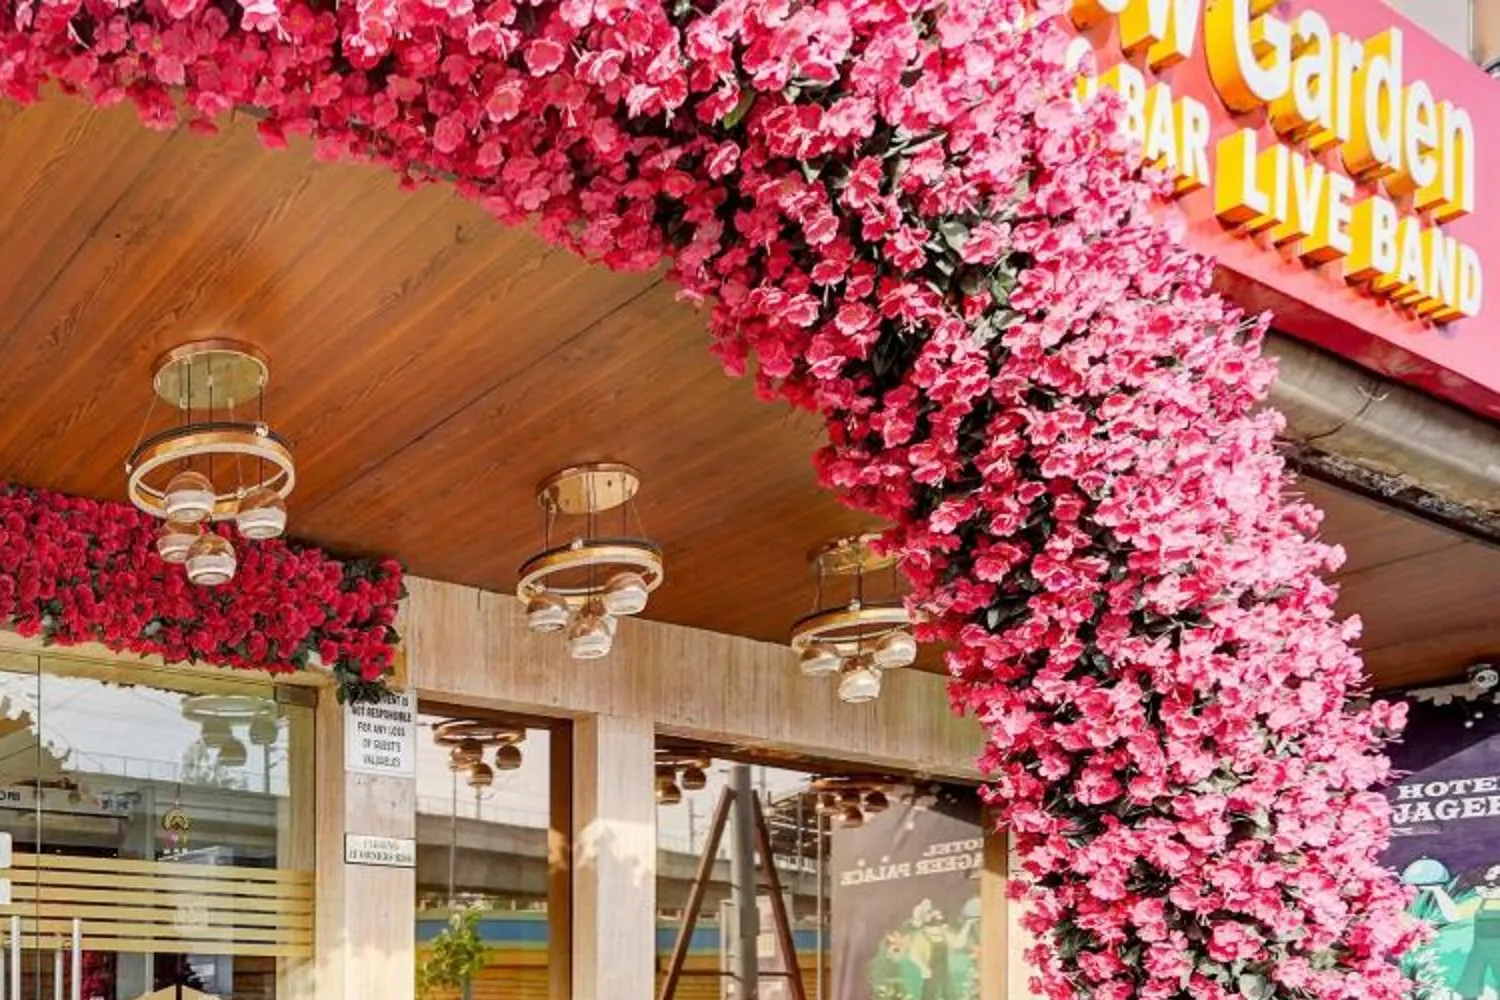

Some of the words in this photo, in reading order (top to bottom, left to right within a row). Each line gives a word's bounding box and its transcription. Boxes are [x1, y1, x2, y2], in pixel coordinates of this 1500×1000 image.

[1114, 63, 1211, 188] BAR
[1228, 128, 1355, 260] LIVE
[1358, 196, 1482, 319] BAND
[1220, 0, 1475, 216] Garden
[1396, 776, 1500, 800] HOTE
